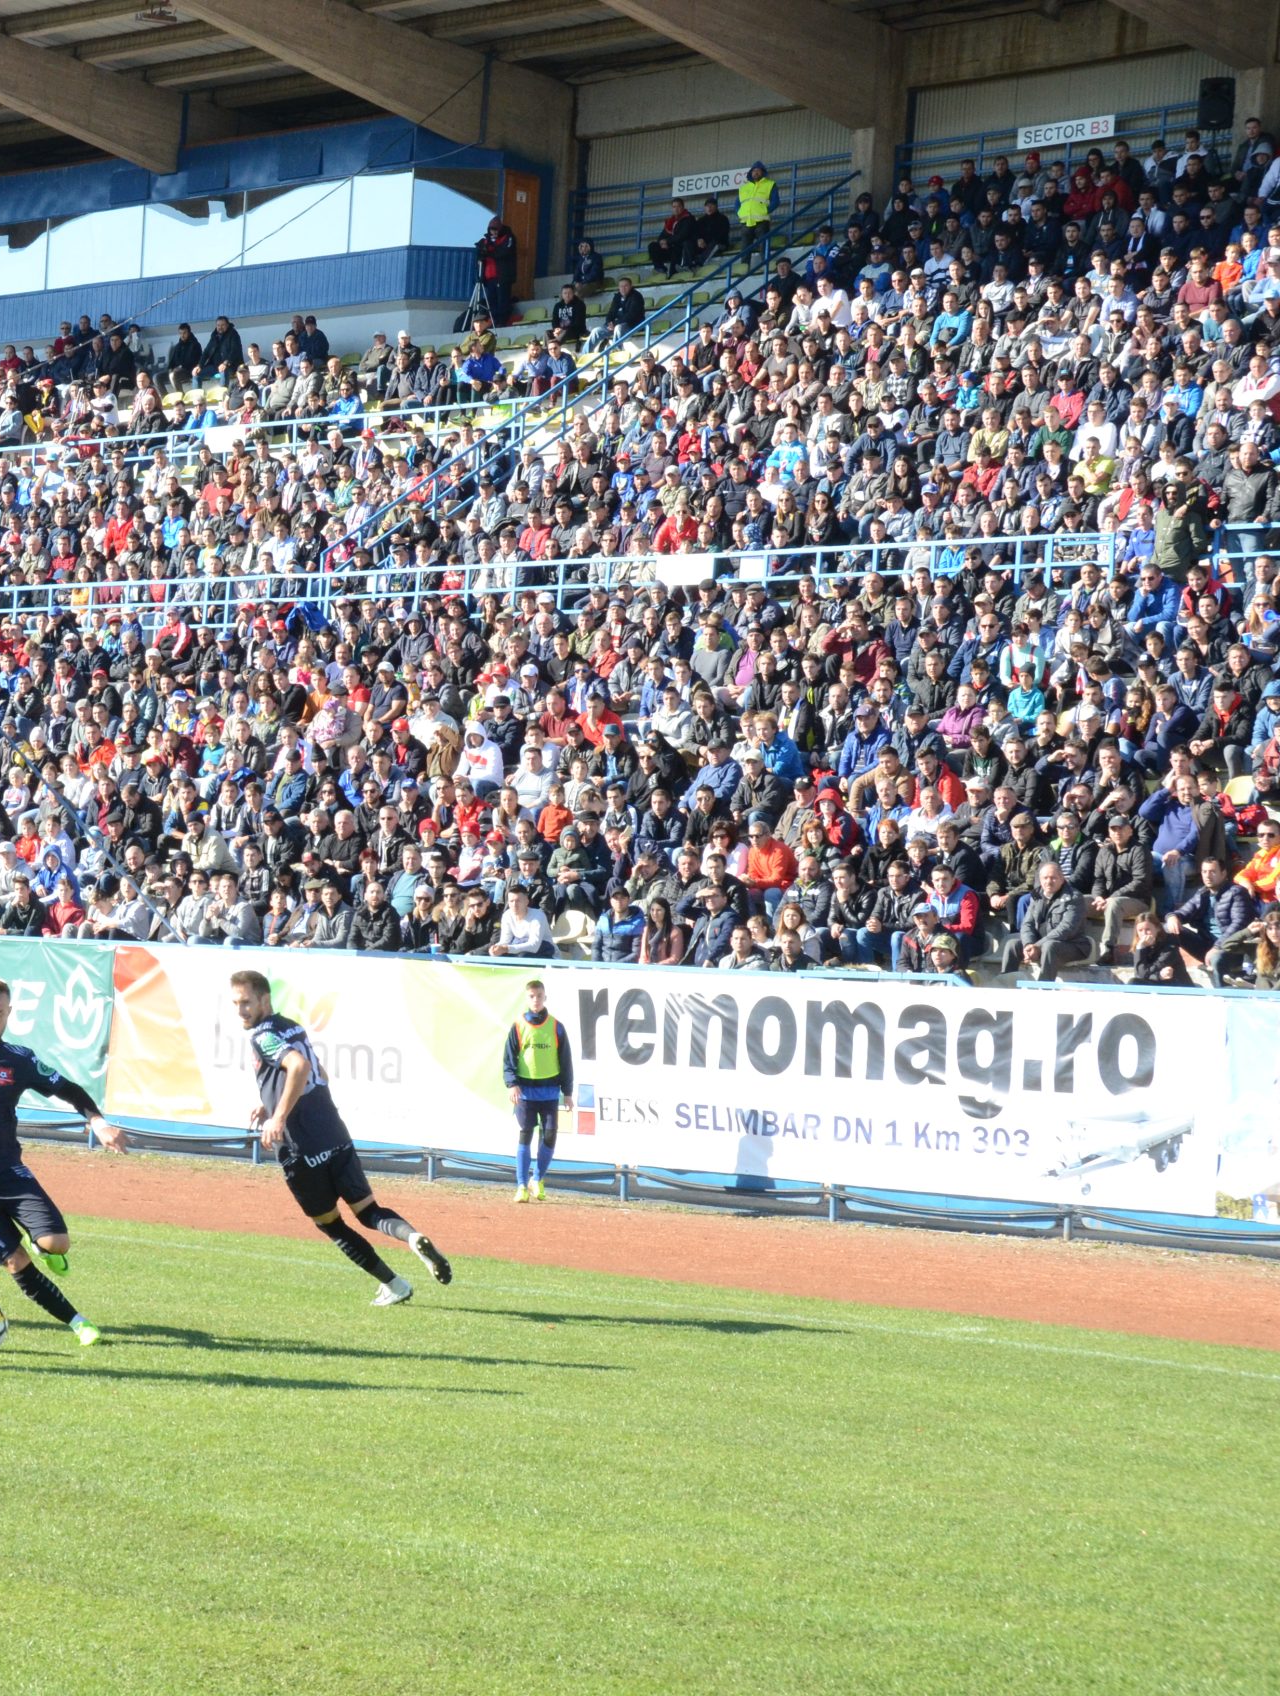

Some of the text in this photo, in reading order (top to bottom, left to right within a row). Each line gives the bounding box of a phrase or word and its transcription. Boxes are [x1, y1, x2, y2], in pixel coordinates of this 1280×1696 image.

[1023, 119, 1109, 144] SECTOR B3
[677, 174, 729, 193] SECTOR
[578, 986, 1157, 1120] remomag.ro
[599, 1096, 1031, 1157] EESS SELIMBAR DN 1 Km 303
